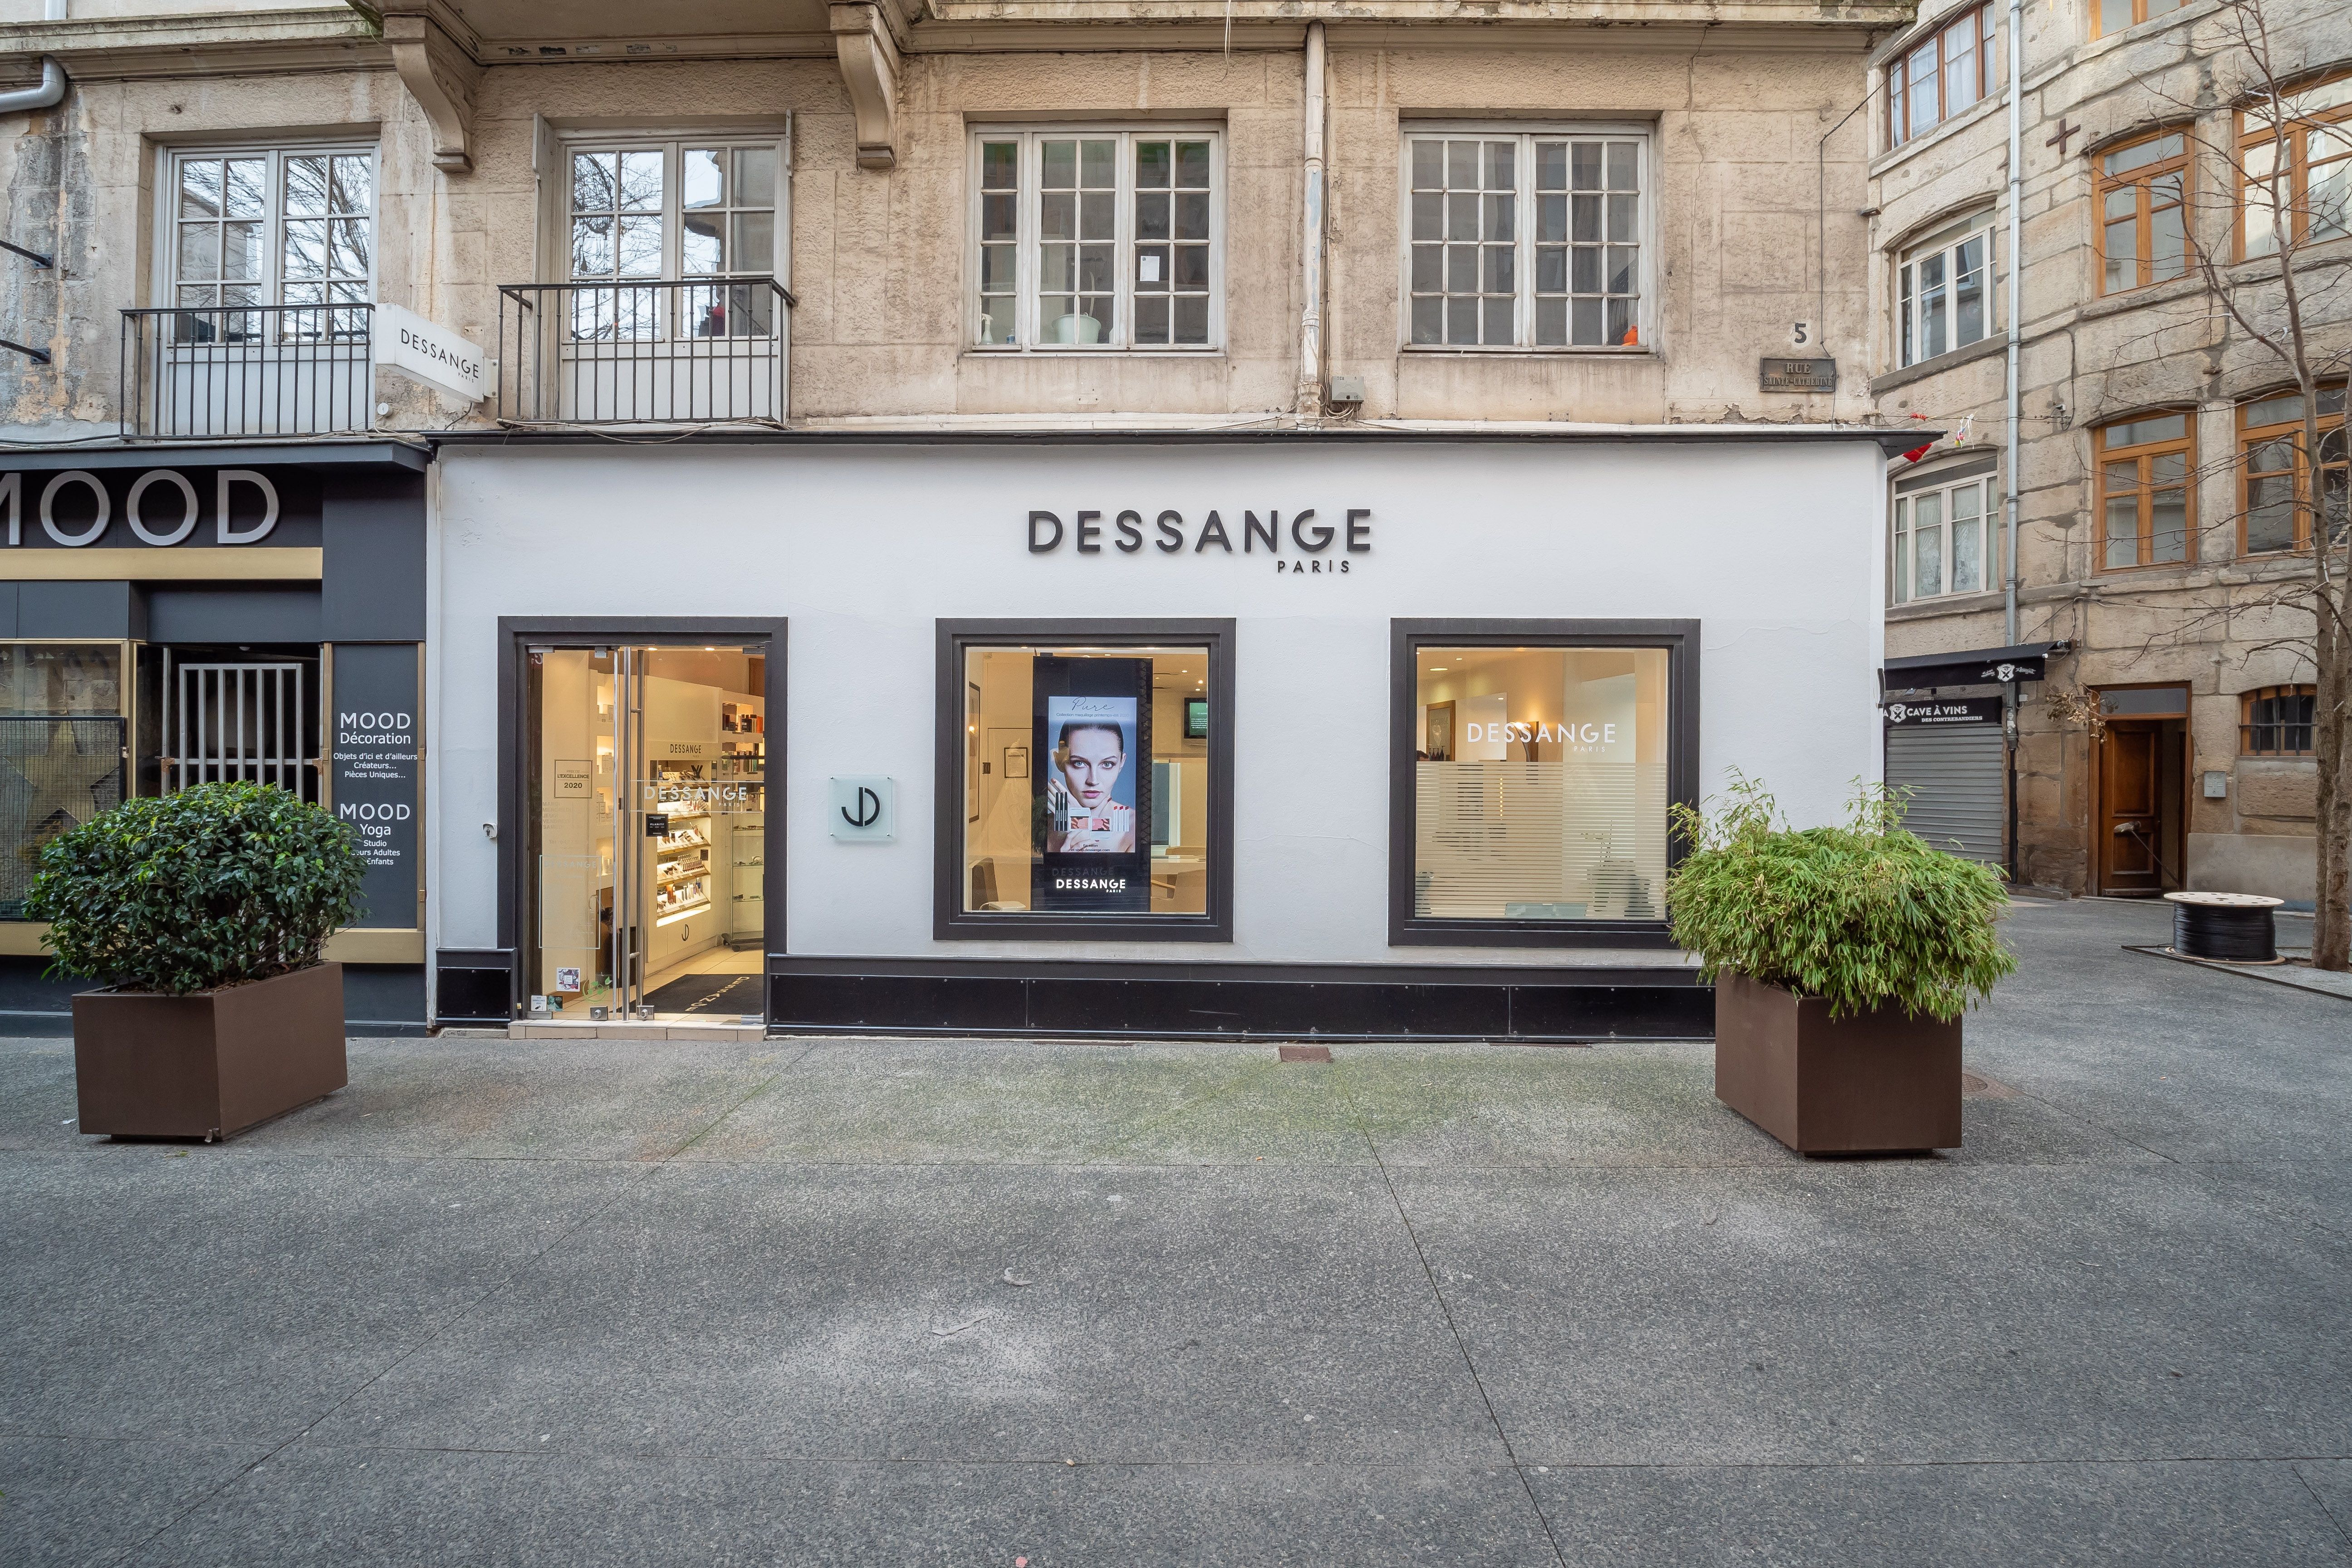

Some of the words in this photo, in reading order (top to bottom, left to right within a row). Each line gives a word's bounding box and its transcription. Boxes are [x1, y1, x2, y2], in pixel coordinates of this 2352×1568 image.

[1794, 323, 1807, 343] 5
[401, 328, 479, 378] DESSANGE
[1786, 363, 1811, 373] RUE
[458, 372, 474, 383] PARIS
[1028, 509, 1371, 552] DESSANGE
[1278, 560, 1349, 573] PARIS
[1072, 696, 1115, 711] Pure
[1907, 707, 1931, 716] CAVE
[1933, 705, 1941, 715] À
[1943, 706, 1967, 715] VINS
[340, 713, 411, 729] MOOD
[340, 731, 411, 744] Décoration
[1468, 723, 1615, 743] DESSANGE
[670, 744, 701, 754] DESSANGE
[369, 771, 406, 779] Uniques...
[645, 786, 747, 800] DESSANGE
[340, 804, 410, 820] MOOD
[360, 824, 391, 838] Yoga
[1056, 879, 1126, 889] DESSANGE
[685, 976, 750, 1011] DESSANGE
